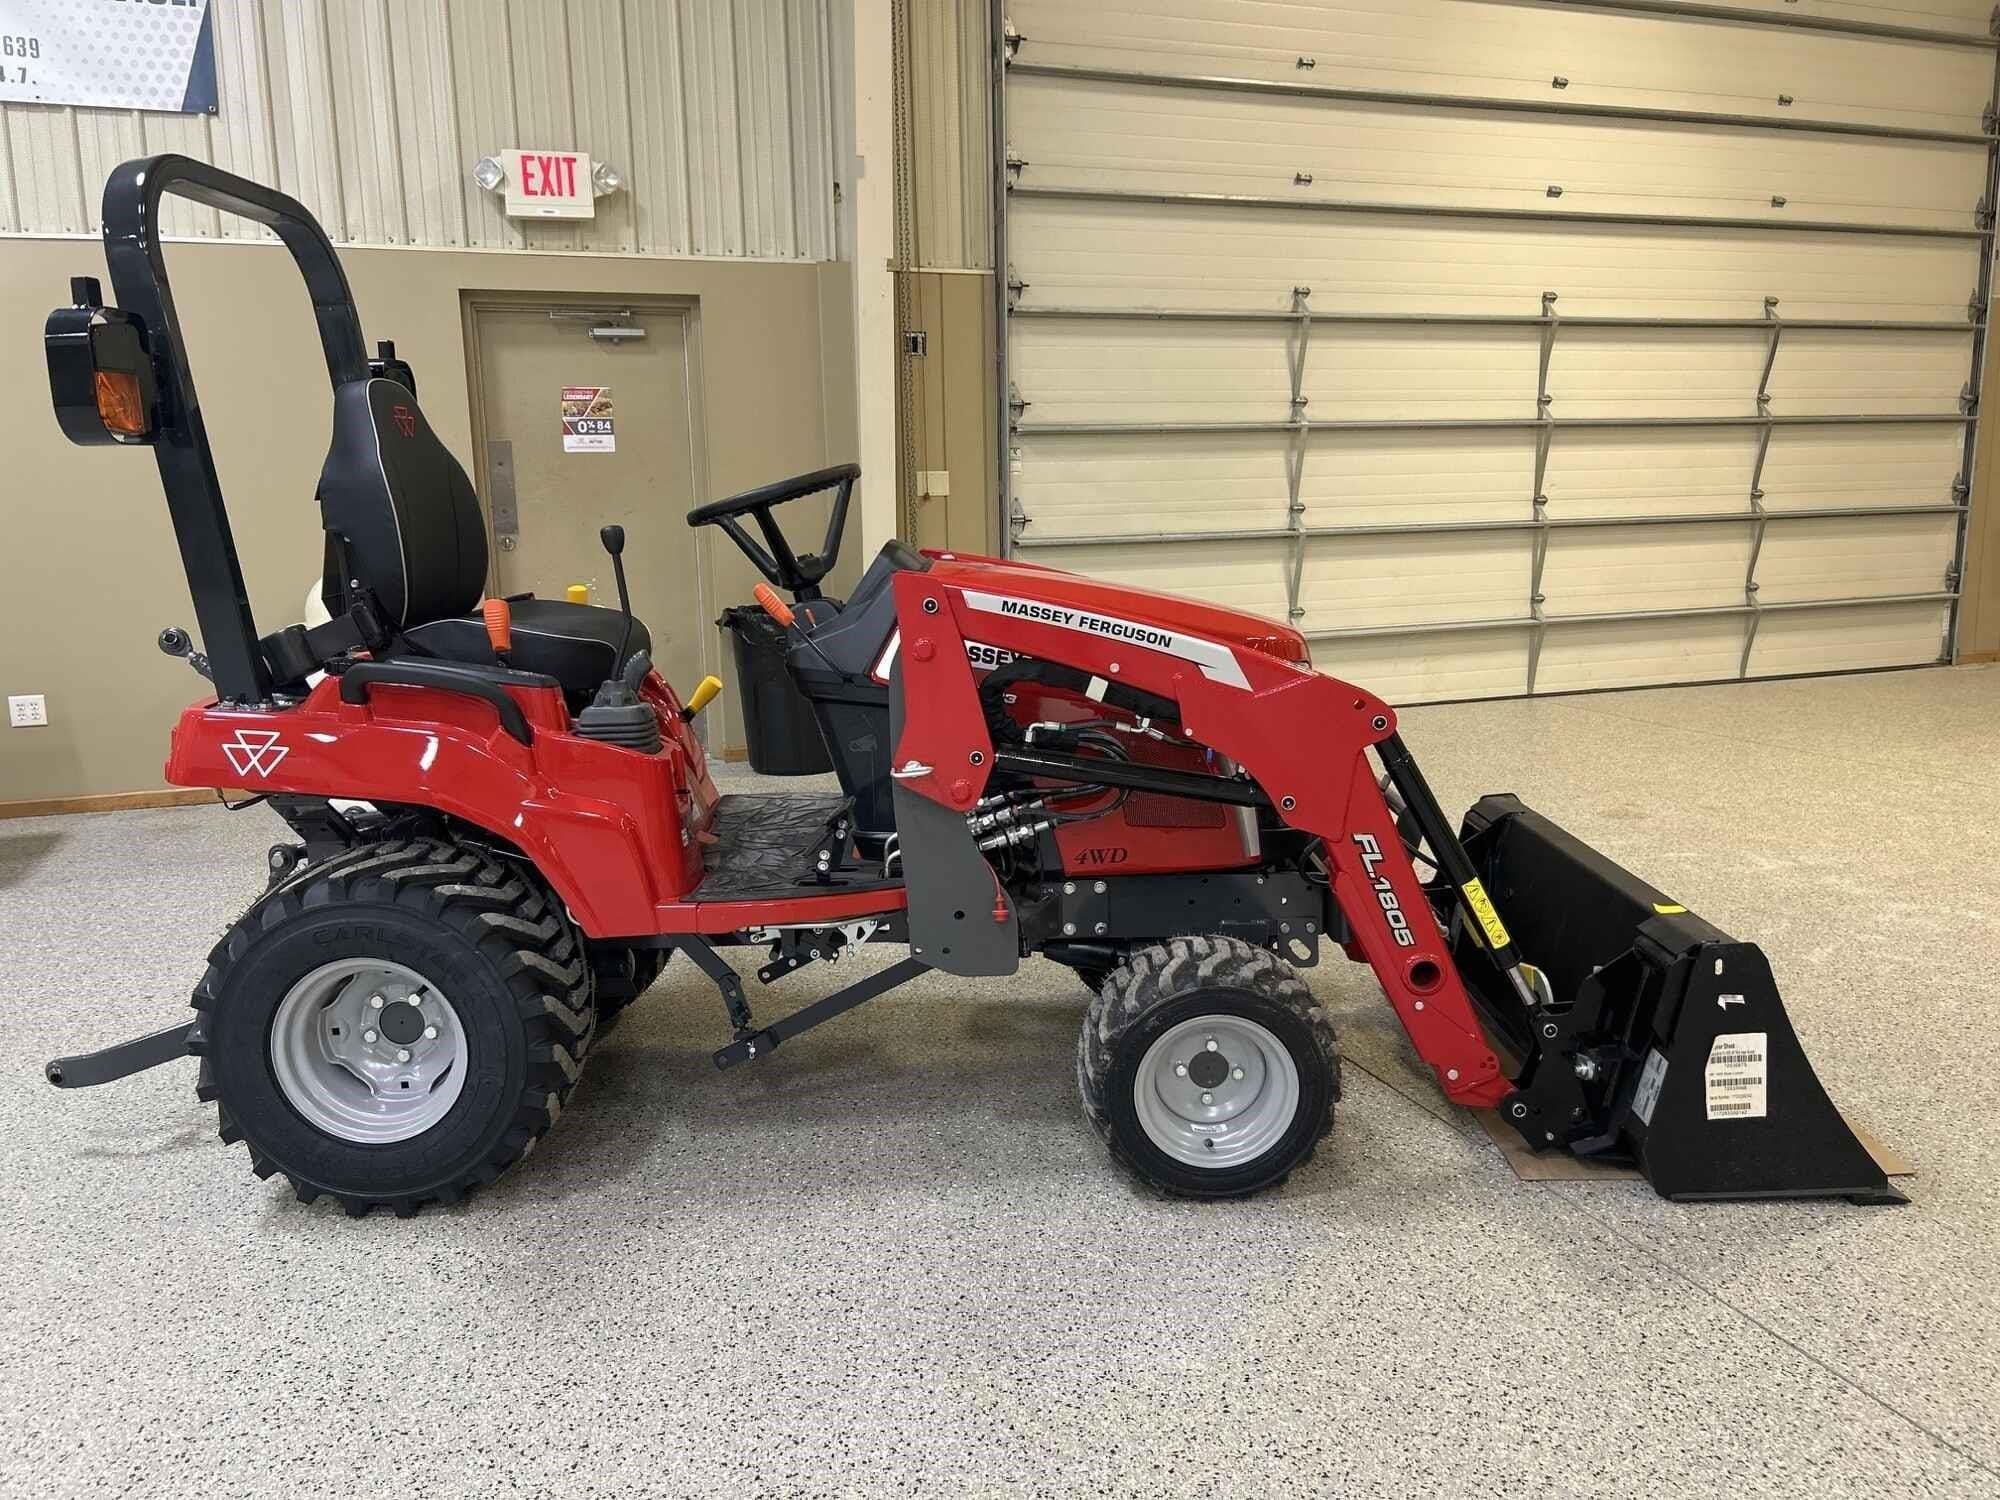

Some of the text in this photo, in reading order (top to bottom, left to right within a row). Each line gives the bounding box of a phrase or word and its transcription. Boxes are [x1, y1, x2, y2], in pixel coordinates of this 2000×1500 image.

[520, 155, 577, 197] EXIT
[597, 421, 611, 430] 84
[1001, 600, 1172, 648] MASSEY FERGUSON
[1073, 847, 1128, 865] 4WD
